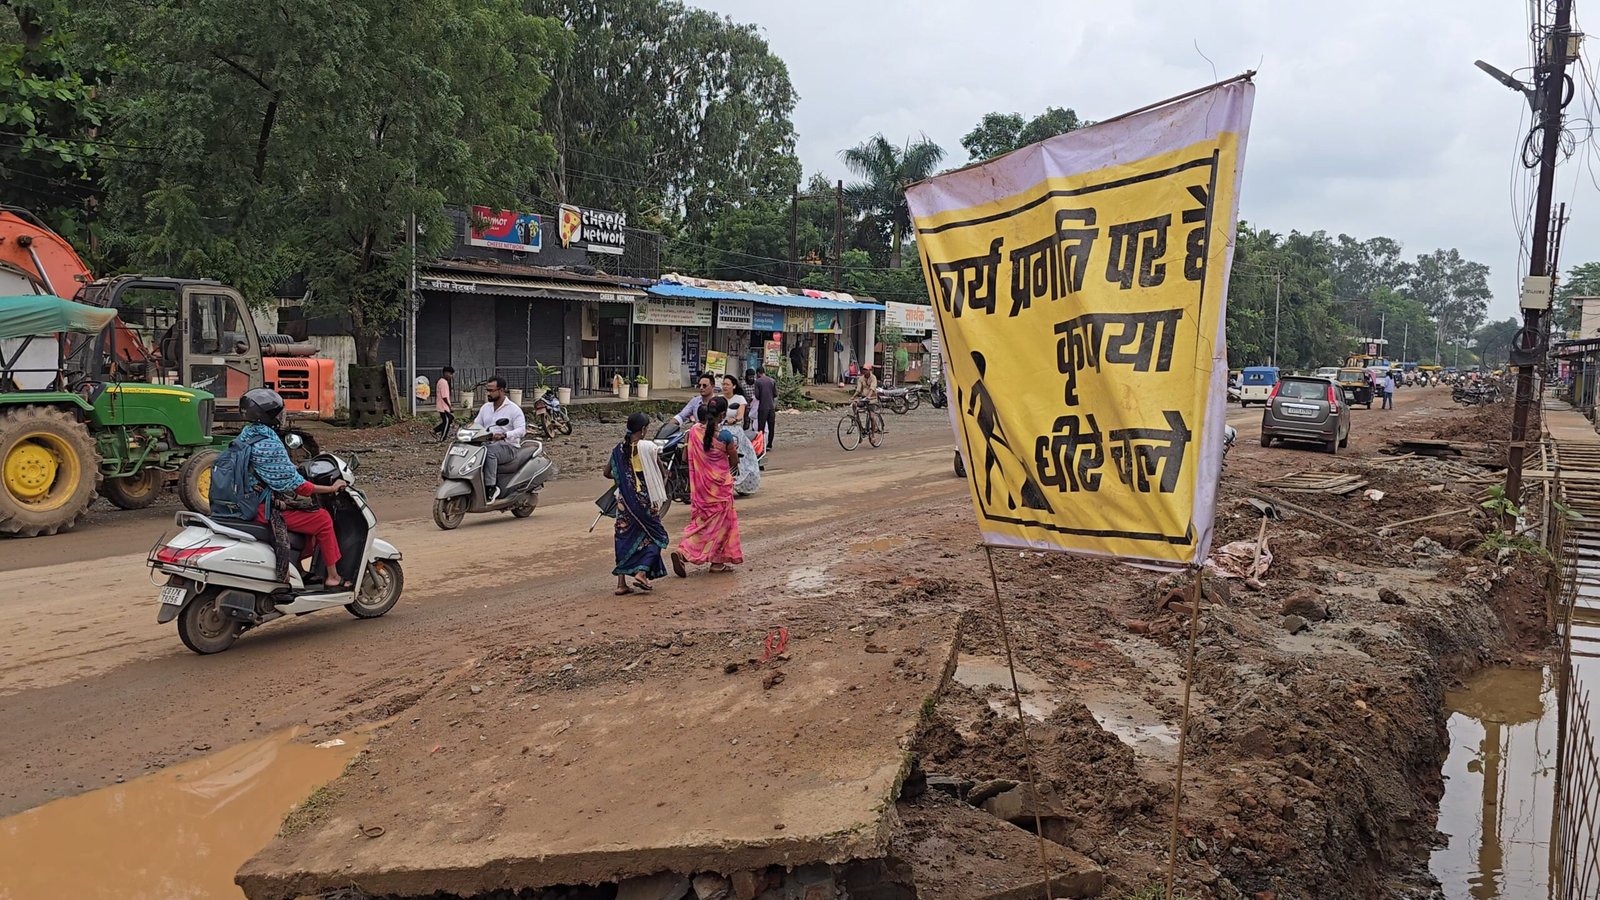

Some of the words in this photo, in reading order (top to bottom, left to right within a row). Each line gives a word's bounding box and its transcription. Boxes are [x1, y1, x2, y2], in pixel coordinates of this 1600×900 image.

[1009, 207, 1099, 316] प्रगति
[1104, 213, 1172, 290] पर
[719, 304, 751, 317] SARTHAK
[1054, 308, 1184, 406] कृपया
[1035, 413, 1104, 492] धीरे
[1109, 410, 1192, 493] चले
